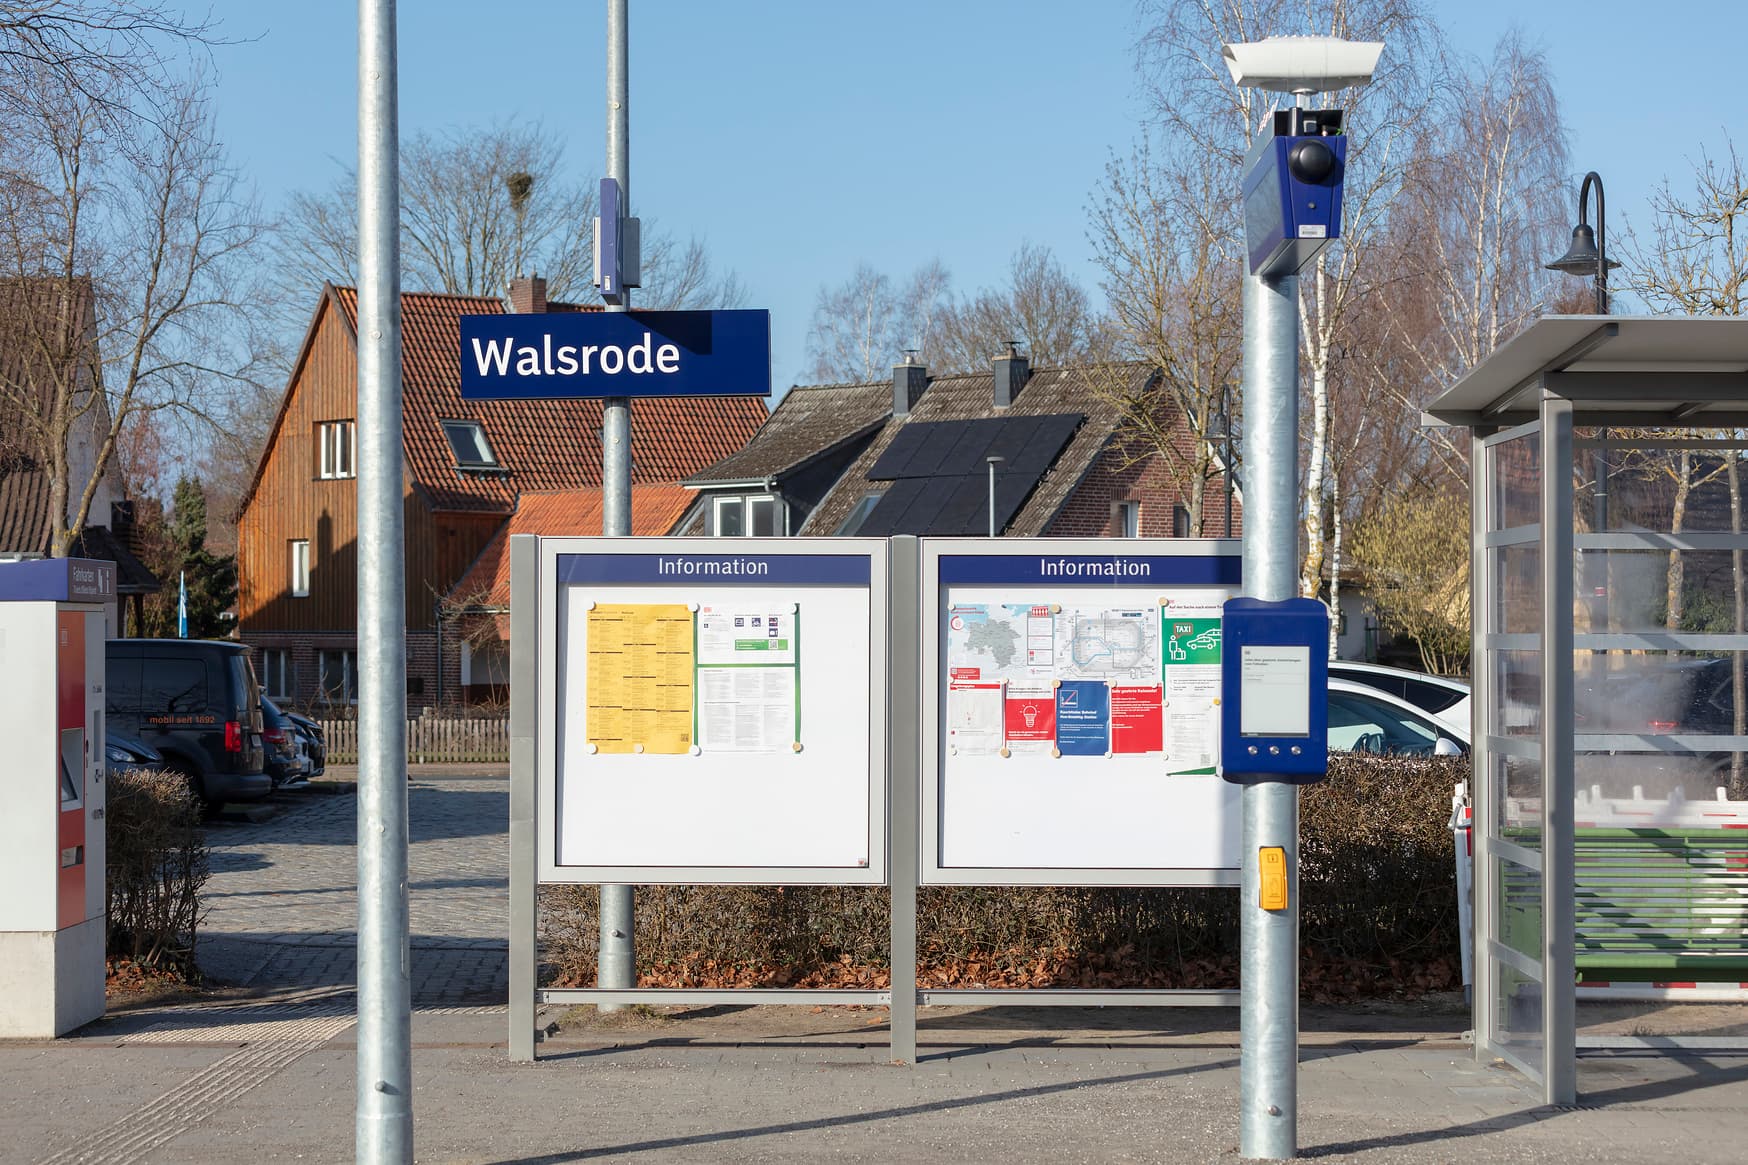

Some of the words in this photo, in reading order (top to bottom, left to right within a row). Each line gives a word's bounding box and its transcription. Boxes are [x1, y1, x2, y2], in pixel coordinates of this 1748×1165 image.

[471, 332, 680, 377] Walsrode
[659, 557, 768, 575] Information
[1041, 558, 1150, 576] Information
[1175, 625, 1191, 633] TAXI
[149, 714, 174, 724] mobil
[175, 715, 193, 724] seit
